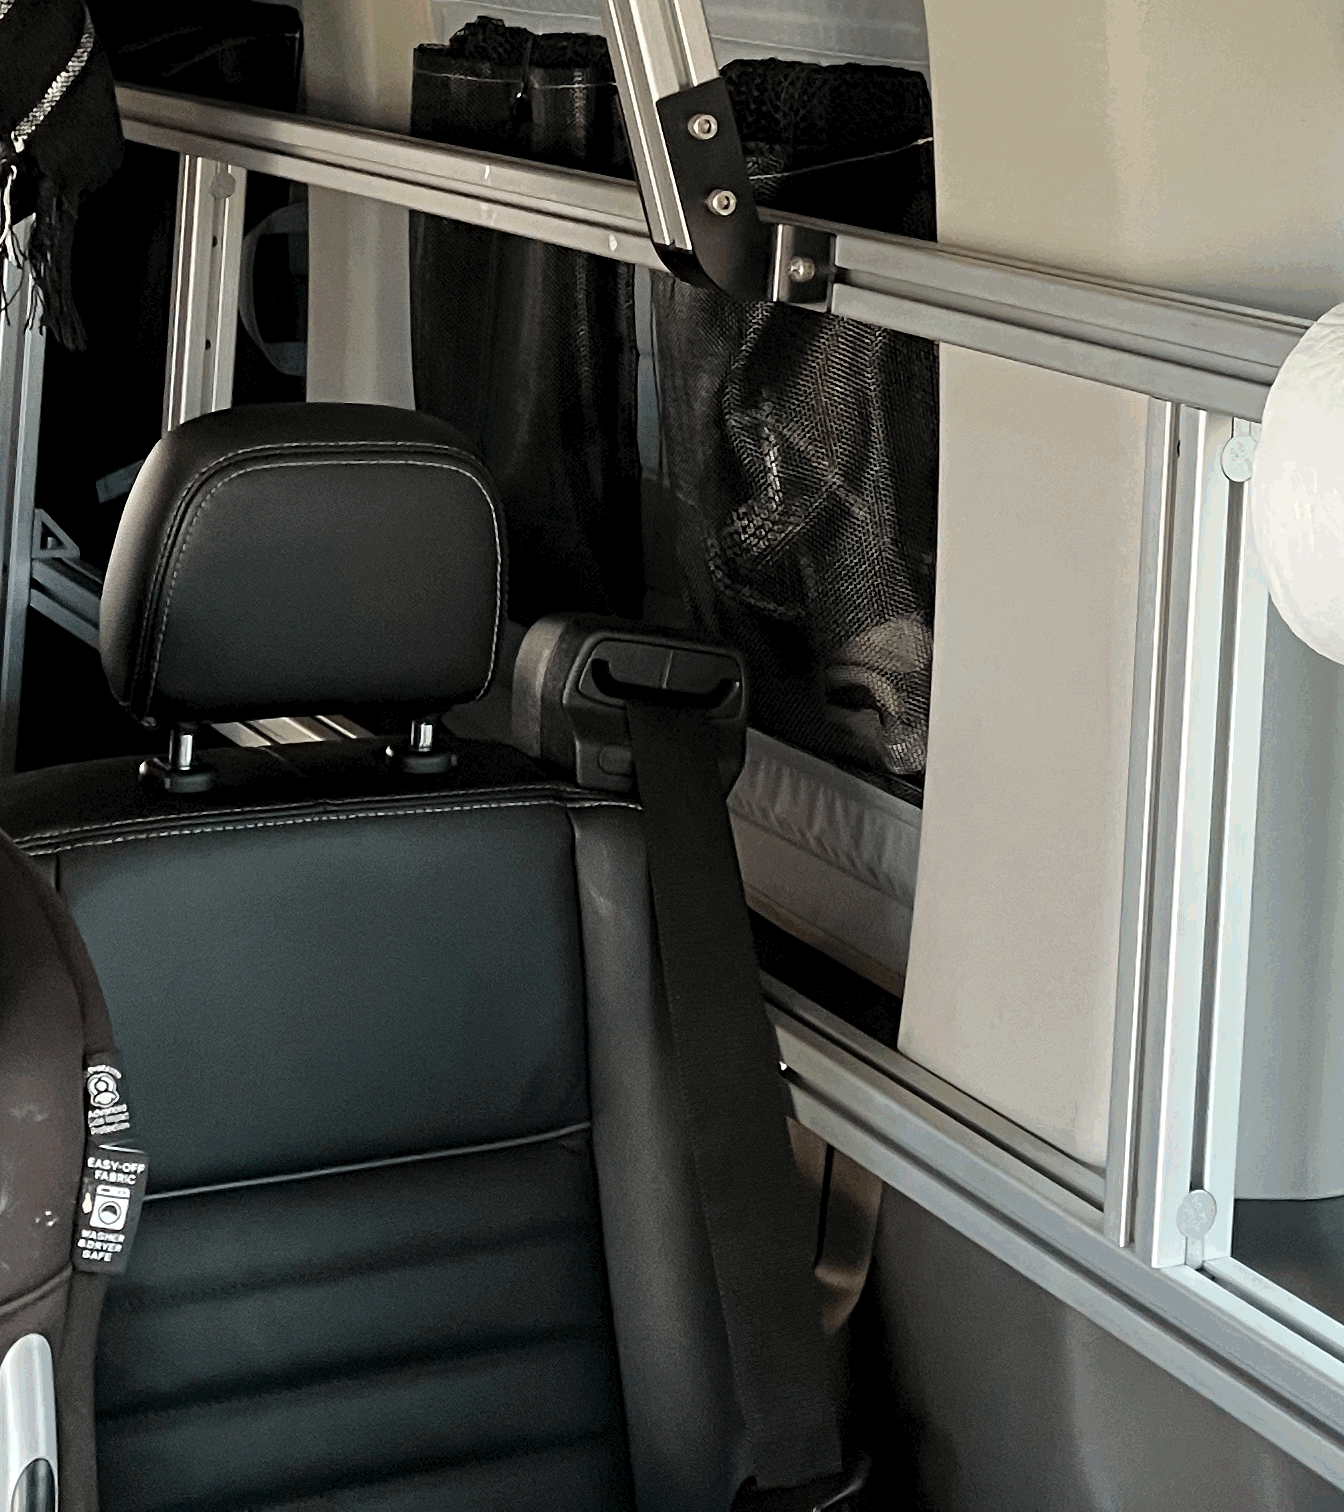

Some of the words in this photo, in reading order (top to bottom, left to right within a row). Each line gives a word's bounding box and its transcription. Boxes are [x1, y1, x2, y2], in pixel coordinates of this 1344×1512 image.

[87, 1156, 145, 1174] EASY-OFF
[94, 1169, 136, 1185] FABRIC
[81, 1229, 125, 1243] WASHER
[82, 1249, 112, 1262] SAFE
